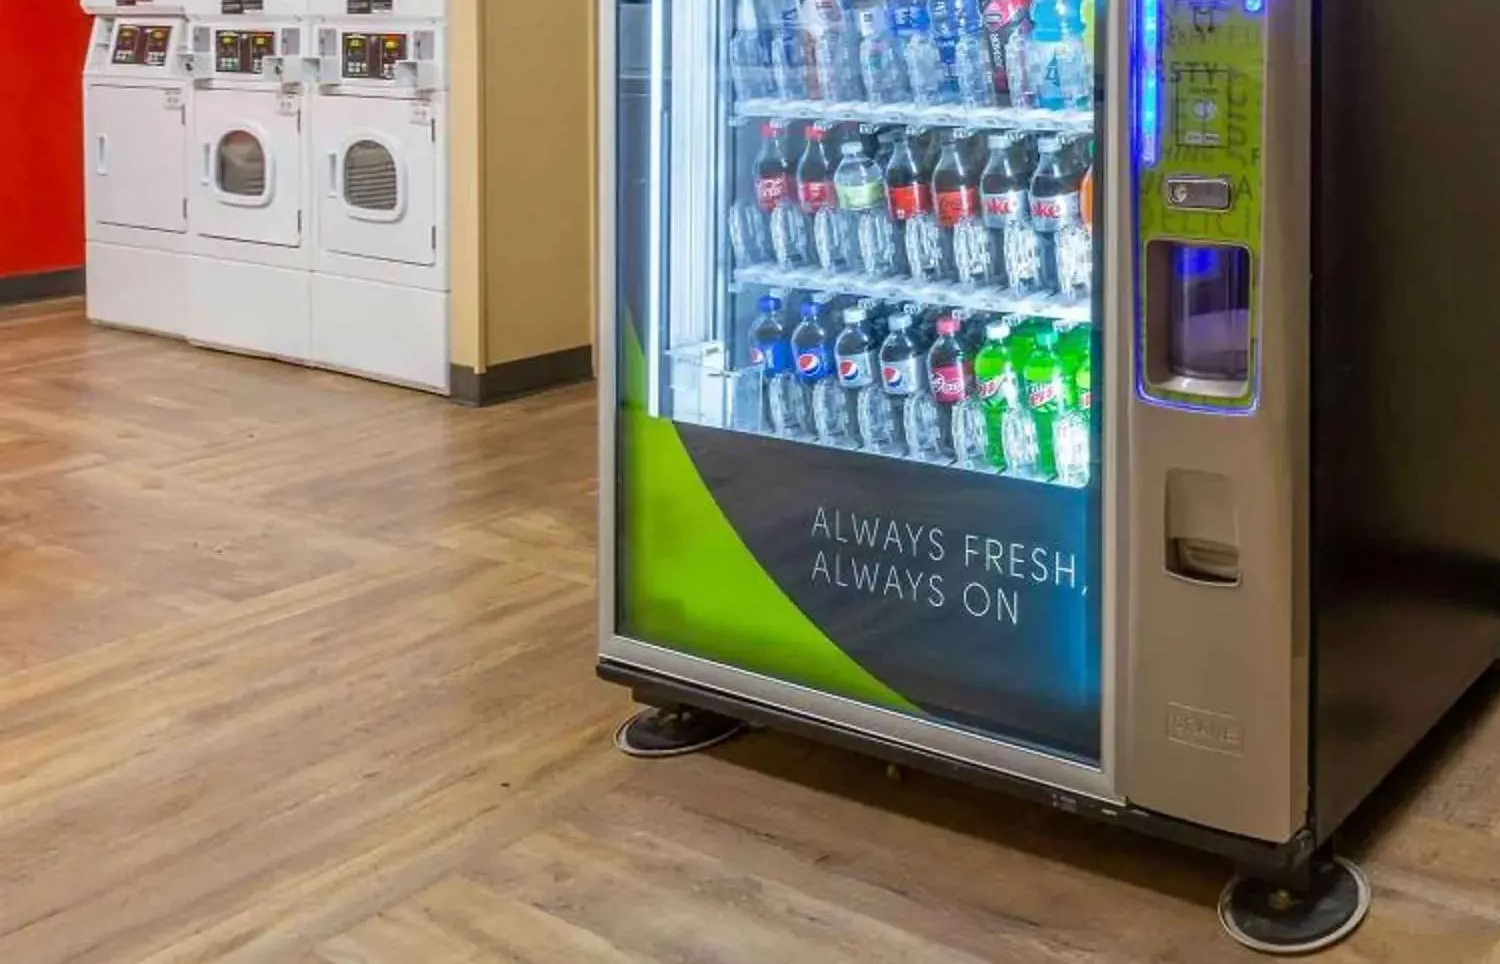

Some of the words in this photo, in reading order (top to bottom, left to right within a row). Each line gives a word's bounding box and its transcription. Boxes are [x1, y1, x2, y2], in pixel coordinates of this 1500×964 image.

[811, 506, 946, 562] ALWAYS
[964, 533, 1088, 597] FRESH,
[811, 550, 946, 608] ALWAYS
[963, 581, 1018, 626] ON
